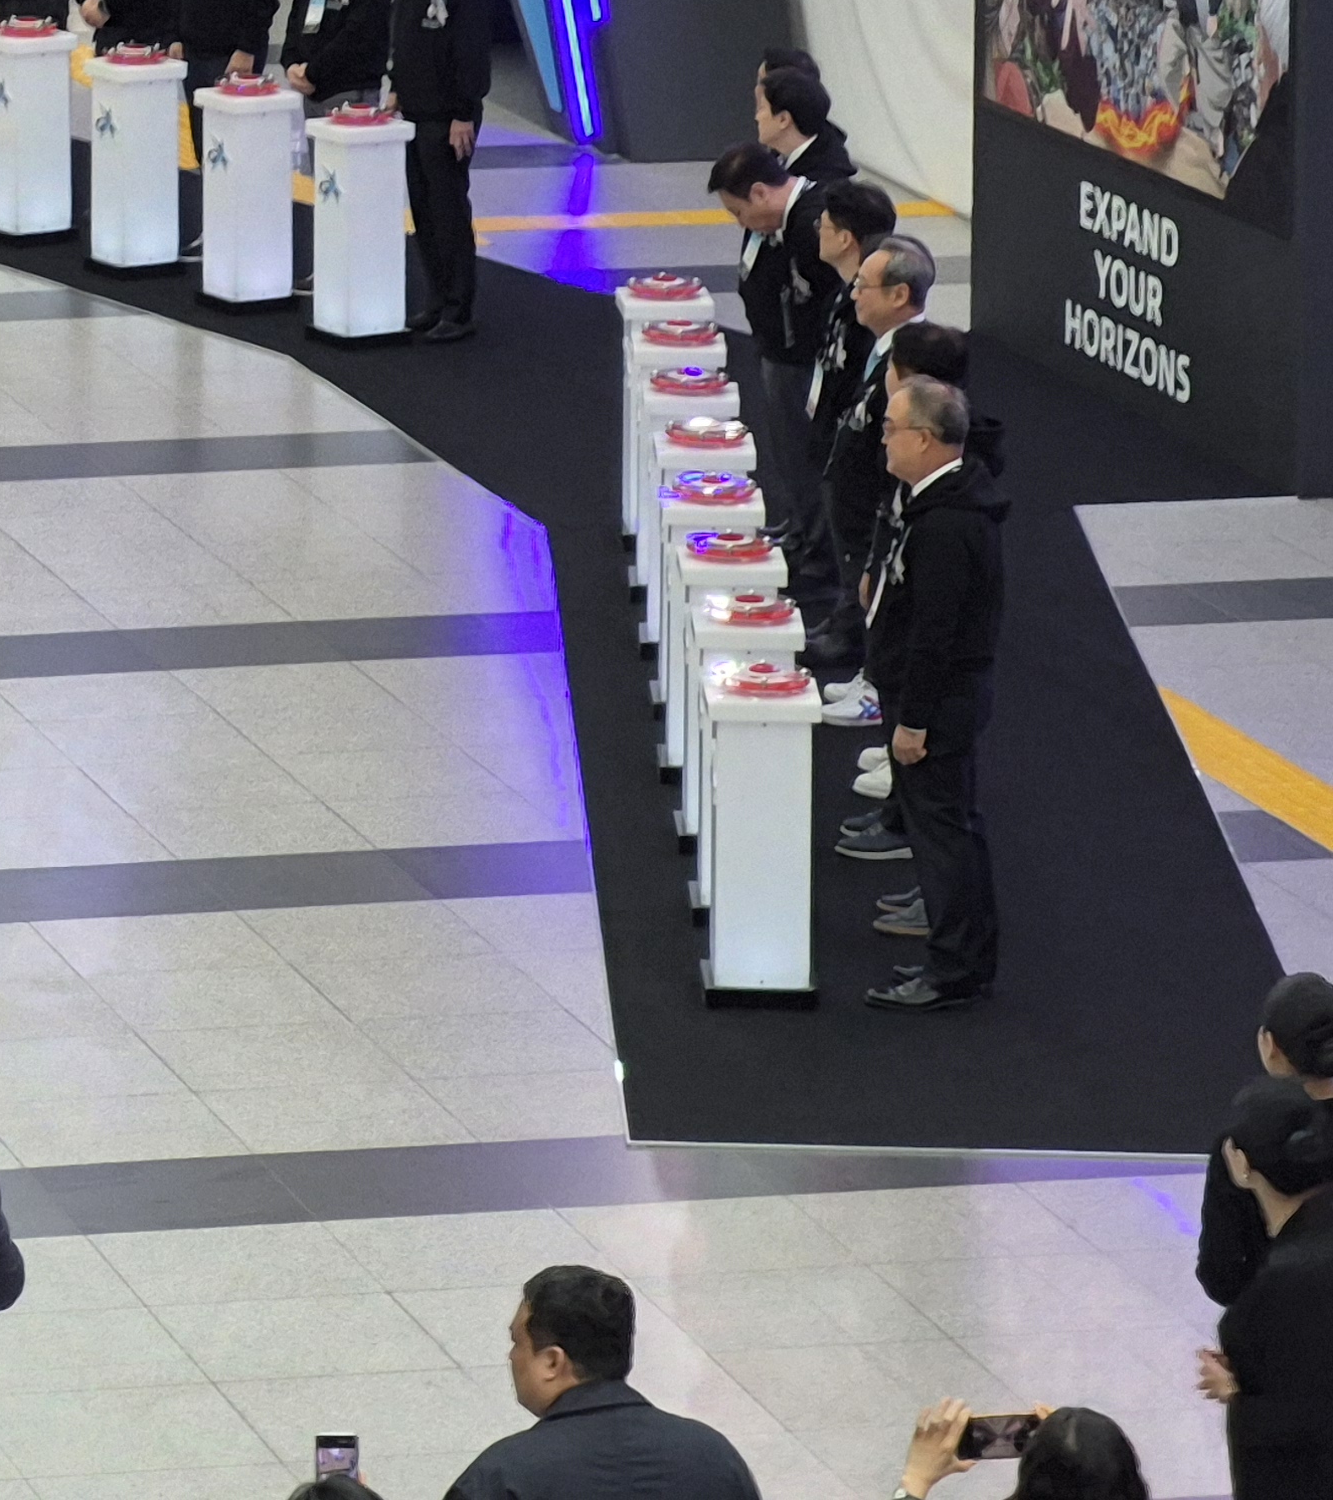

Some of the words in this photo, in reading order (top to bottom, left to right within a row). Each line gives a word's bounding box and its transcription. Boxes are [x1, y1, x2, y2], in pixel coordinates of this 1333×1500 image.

[1079, 180, 1180, 268] EXPAND
[1093, 248, 1164, 328] YOUR
[1064, 298, 1192, 404] HORIZONS
